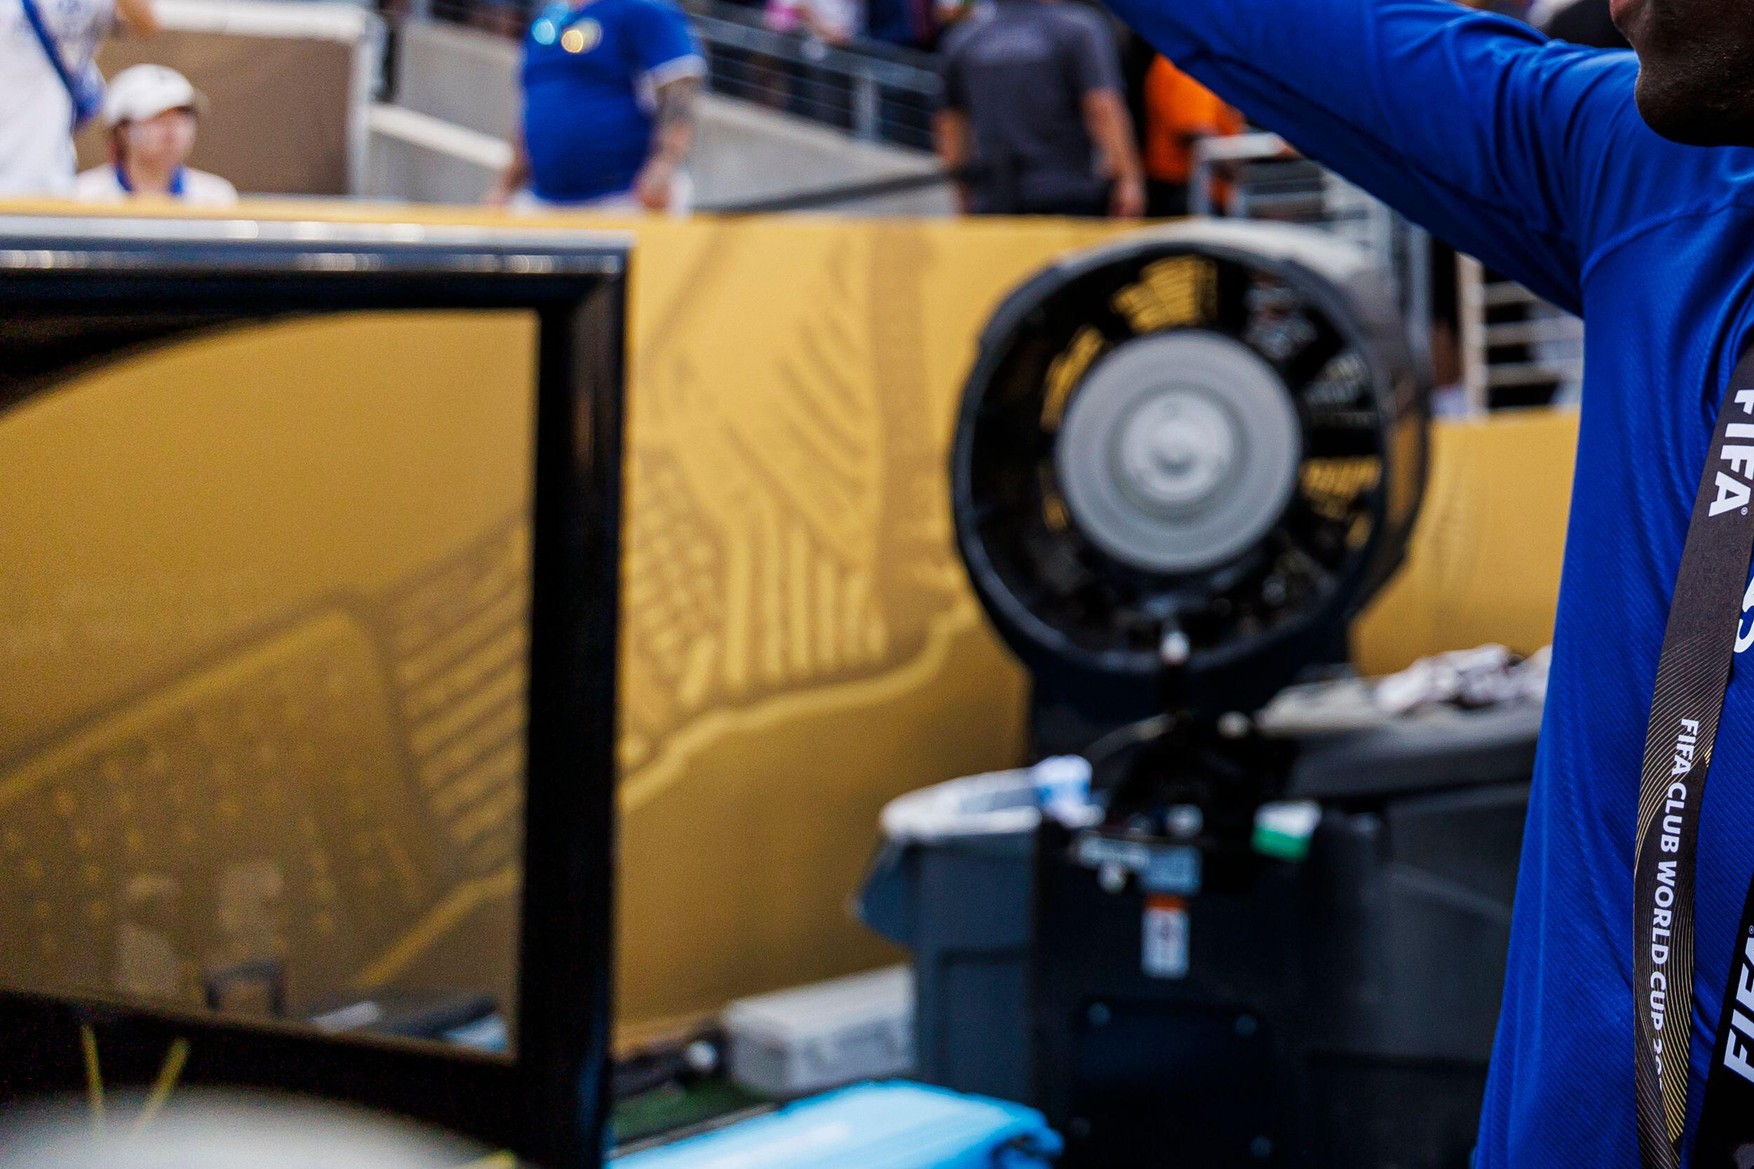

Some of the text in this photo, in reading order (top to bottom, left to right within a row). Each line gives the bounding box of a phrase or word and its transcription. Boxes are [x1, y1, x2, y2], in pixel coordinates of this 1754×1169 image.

[1671, 718, 1700, 776] FIFA
[1660, 782, 1687, 853] CLUB
[1651, 860, 1677, 965] WORLD
[1650, 971, 1666, 1031] CUP
